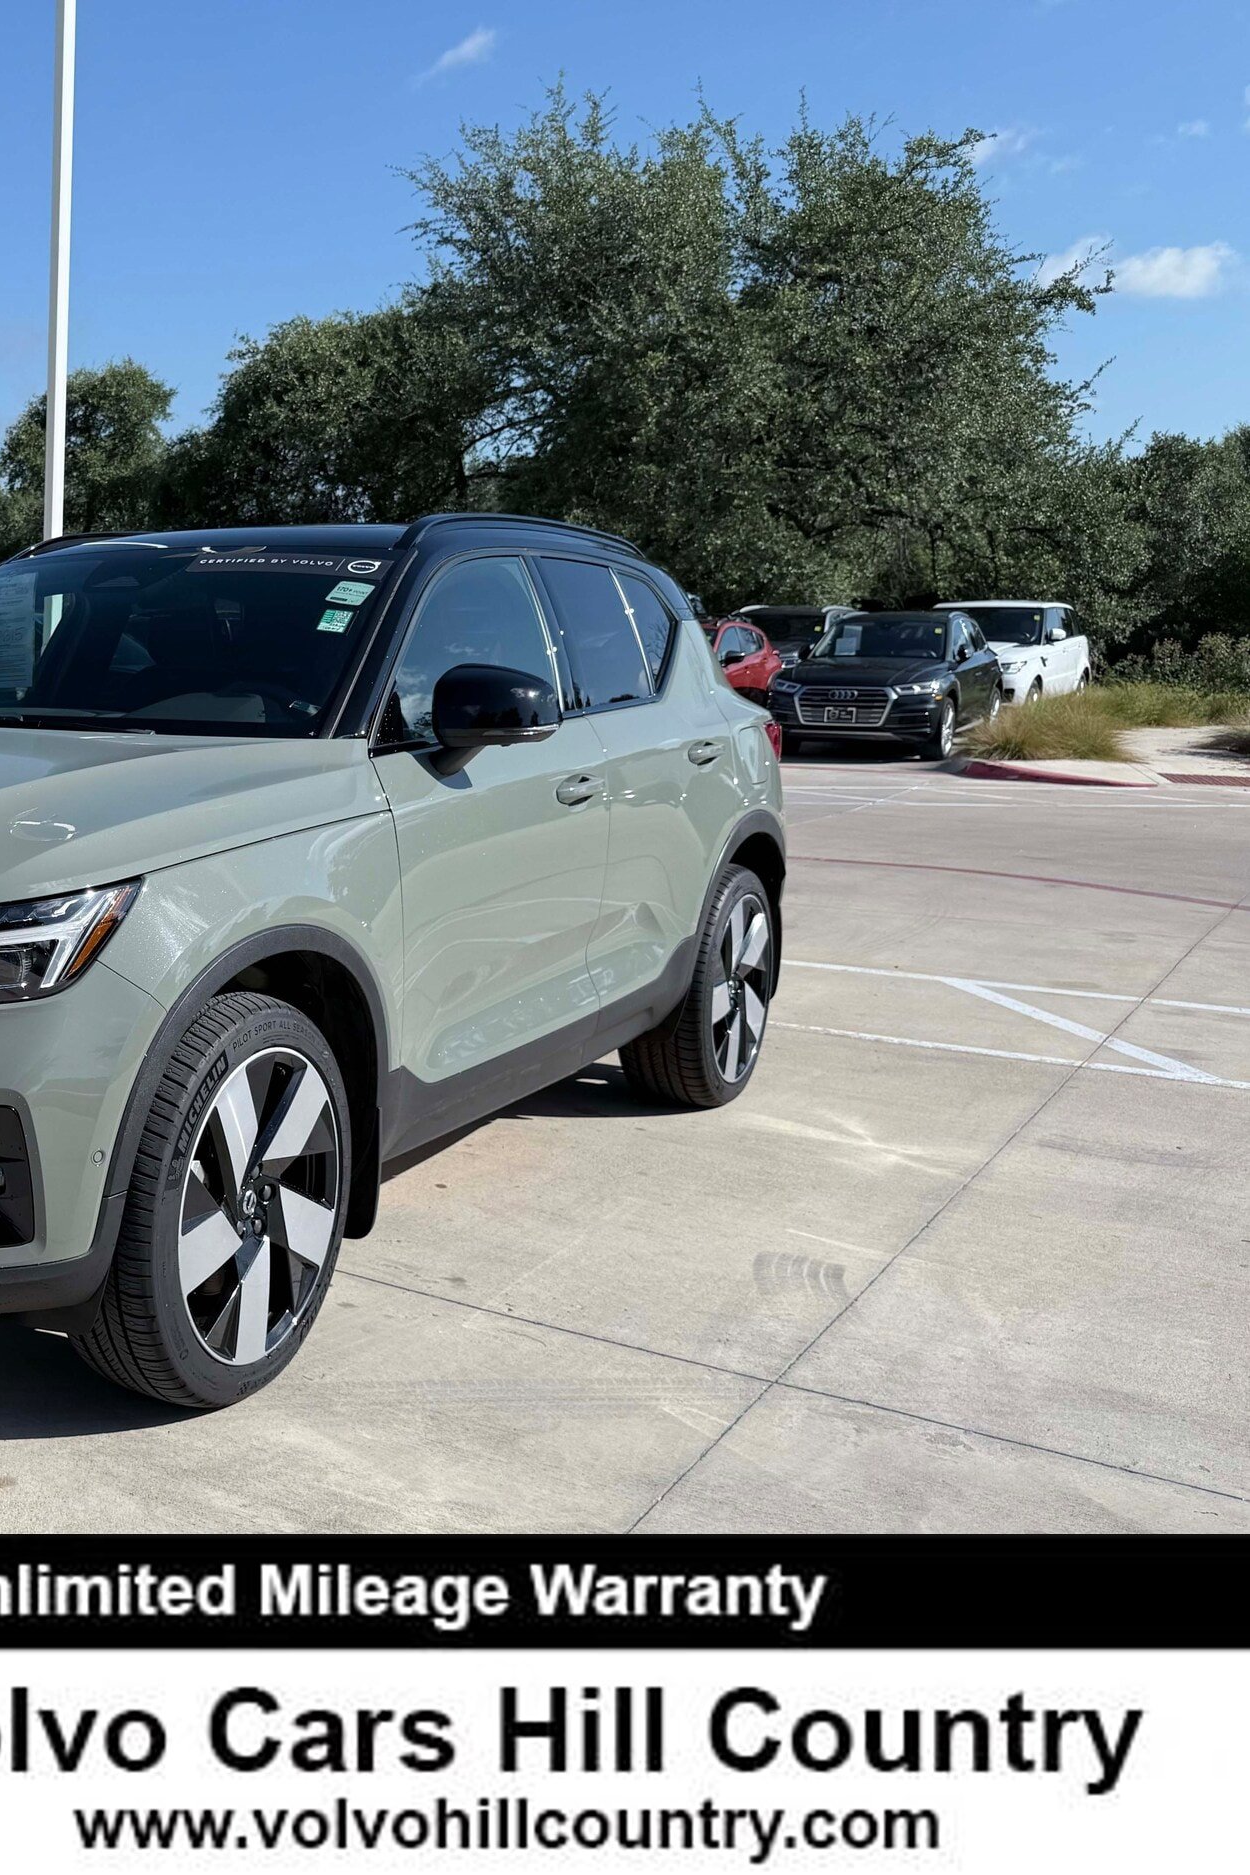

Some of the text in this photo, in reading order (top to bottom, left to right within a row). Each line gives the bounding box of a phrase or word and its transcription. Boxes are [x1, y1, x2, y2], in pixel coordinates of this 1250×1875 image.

[292, 559, 334, 567] VOLVO
[232, 1029, 252, 1051] PILOT
[254, 1021, 276, 1036] SPORT
[279, 1020, 291, 1030] ALL
[177, 1056, 228, 1154] MICHELIN
